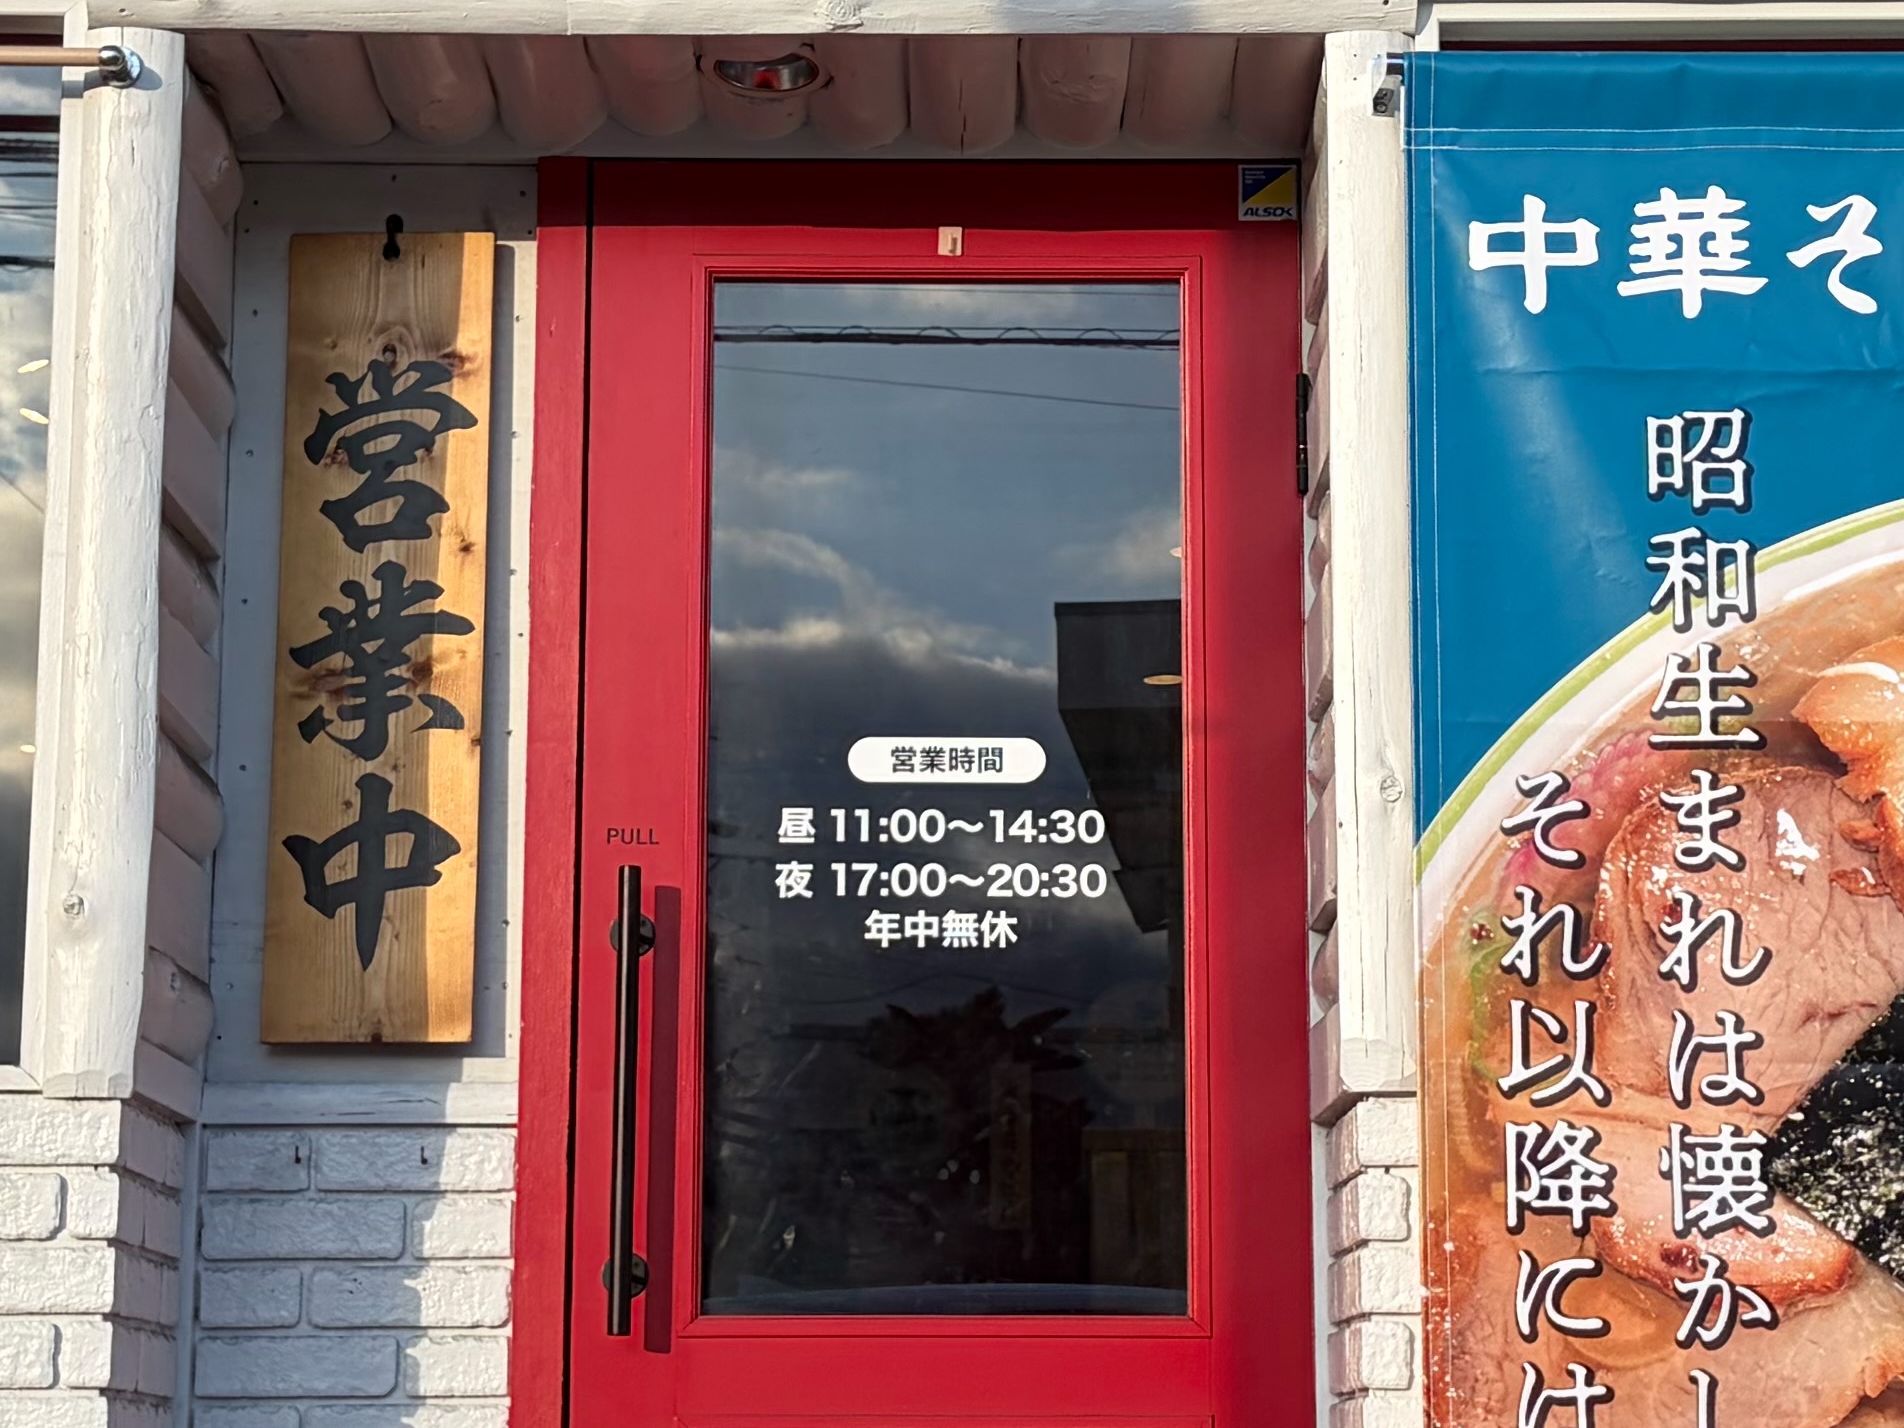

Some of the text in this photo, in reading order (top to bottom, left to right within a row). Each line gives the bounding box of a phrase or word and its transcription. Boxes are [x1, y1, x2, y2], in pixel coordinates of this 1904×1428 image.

[1243, 206, 1293, 218] ALSOK
[282, 358, 480, 970] 営業中
[889, 746, 1005, 775] 営業時間
[606, 827, 660, 846] PULL
[777, 807, 816, 844] 昼
[775, 861, 814, 899] 夜
[864, 909, 1018, 949] 年中無休
